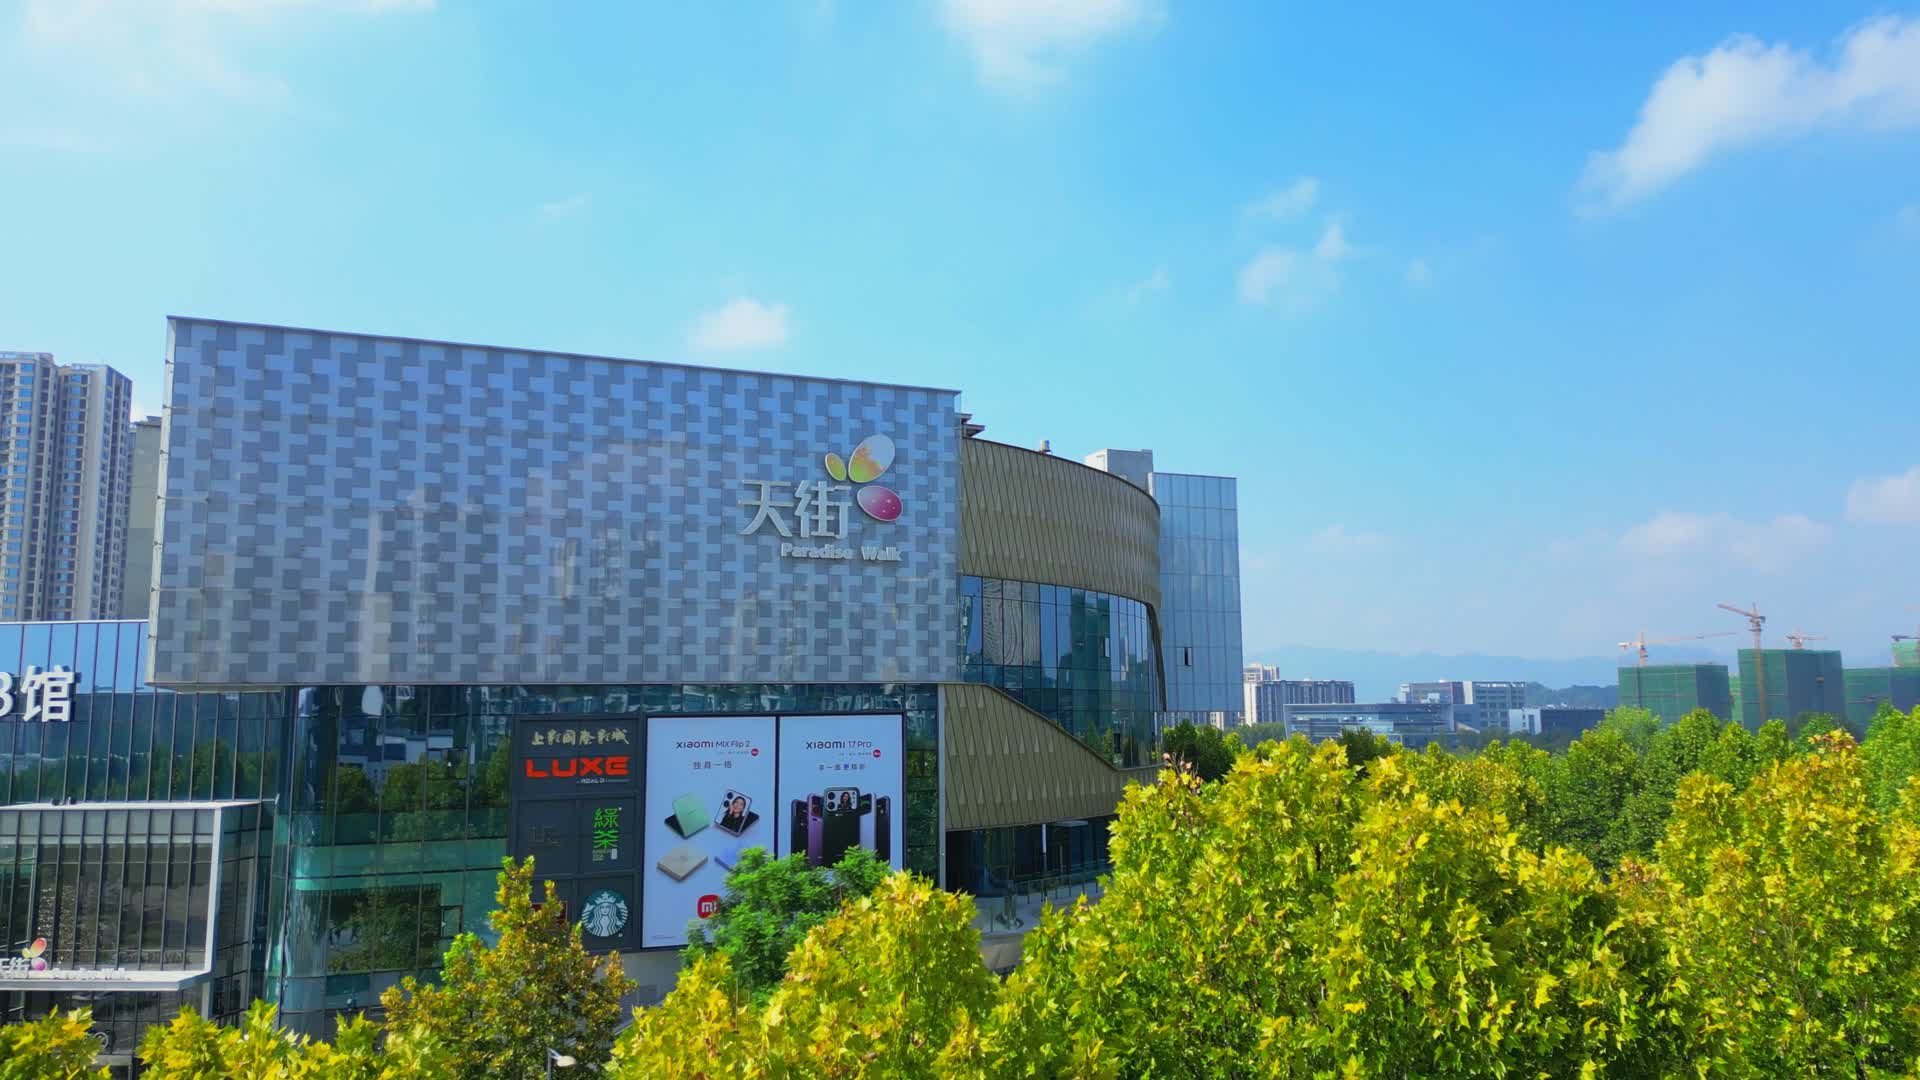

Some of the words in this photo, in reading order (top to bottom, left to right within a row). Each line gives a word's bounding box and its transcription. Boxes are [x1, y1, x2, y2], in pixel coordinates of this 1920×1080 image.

[738, 480, 852, 539] 天街
[781, 543, 852, 559] Paradise
[861, 546, 903, 561] Walk
[857, 740, 872, 748] Pro
[526, 756, 630, 777] LUXE
